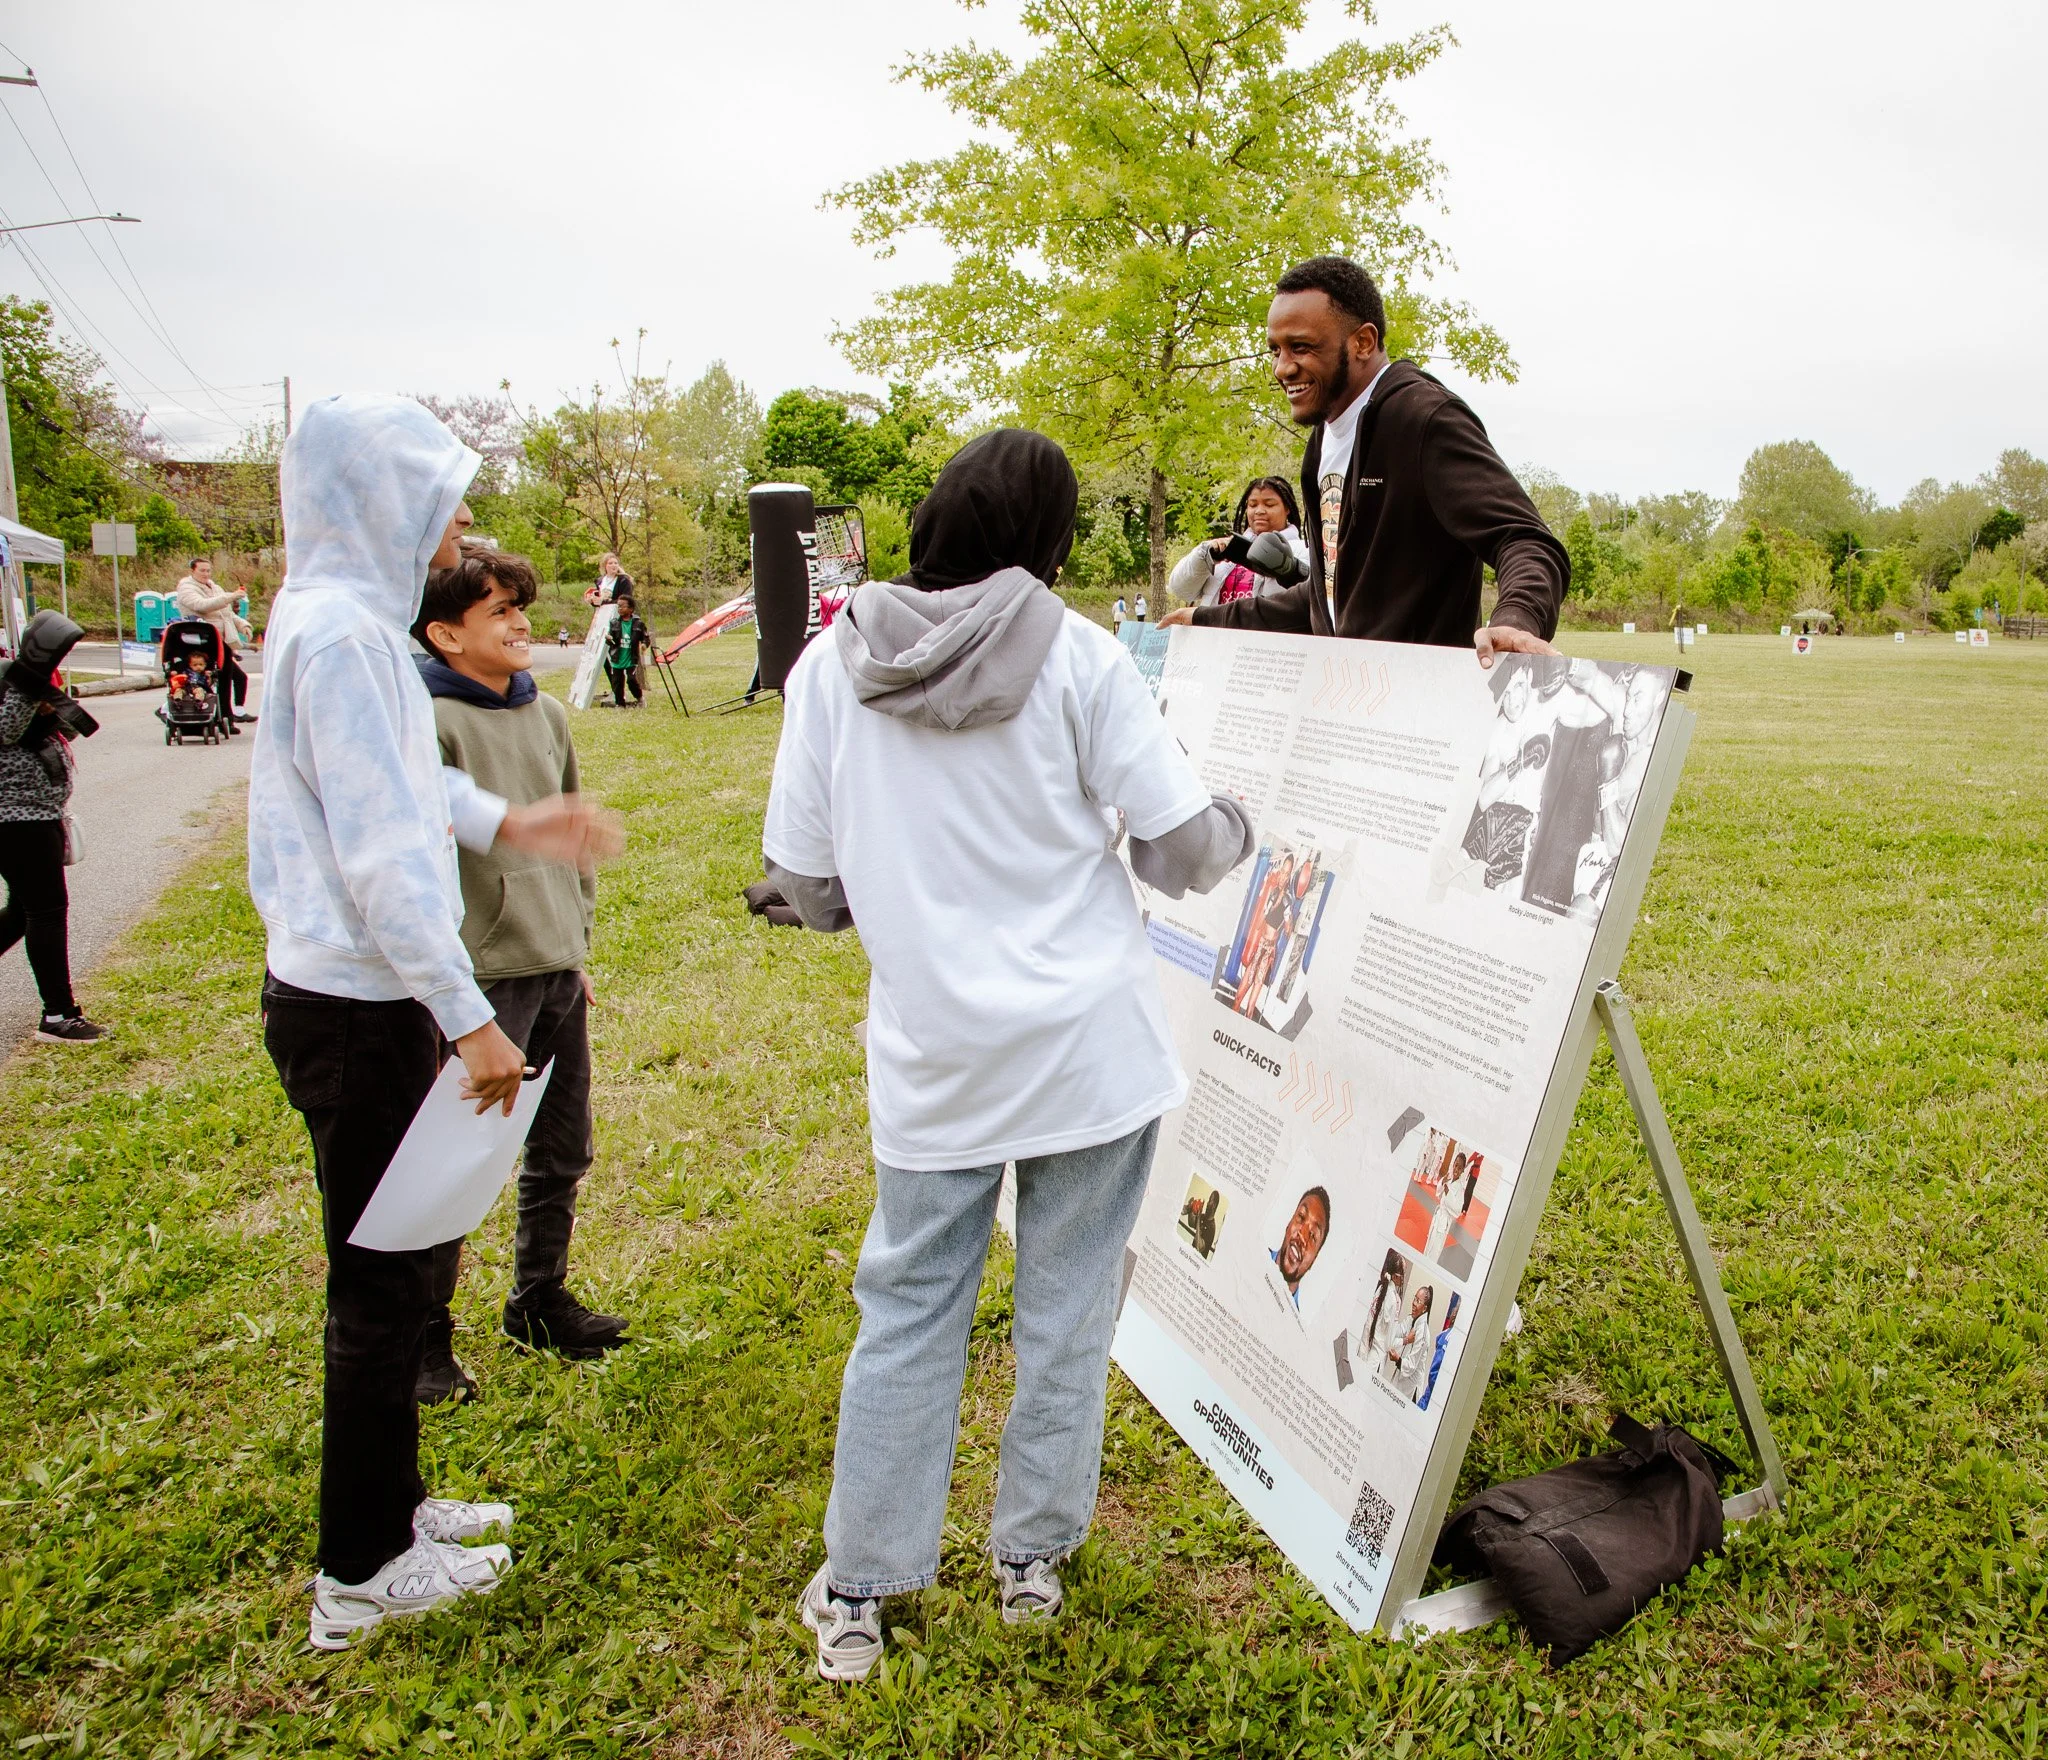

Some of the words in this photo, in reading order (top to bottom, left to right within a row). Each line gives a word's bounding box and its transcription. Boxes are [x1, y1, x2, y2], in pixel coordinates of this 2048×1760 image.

[1423, 800, 1448, 812] Frederick
[1508, 905, 1523, 917] Rocky
[1523, 909, 1539, 921] Jones
[1538, 914, 1554, 925] (right)
[1479, 965, 1496, 977] Gibbs
[1495, 973, 1507, 982] was
[1506, 975, 1518, 986] not
[1516, 979, 1530, 992] just
[1482, 953, 1505, 968] Chester
[1509, 963, 1522, 974] and
[1521, 967, 1532, 978] her
[1530, 971, 1547, 985] story
[1467, 988, 1479, 997] won
[1479, 991, 1489, 1001] her
[1488, 994, 1501, 1006] first
[1500, 999, 1516, 1013] eight
[1471, 1001, 1491, 1015] Valerie
[1482, 979, 1501, 994] player
[1507, 989, 1531, 1004] Chester
[1446, 1003, 1487, 1028] Championship,
[1485, 1020, 1515, 1041] becoming
[1514, 1032, 1526, 1043] the
[1453, 1019, 1471, 1035] (Black
[1469, 1026, 1484, 1040] Belt,
[1482, 1032, 1501, 1048] 2023).
[1213, 1029, 1246, 1057] QUICK
[1246, 1048, 1281, 1077] FACTS
[1445, 1042, 1460, 1055] WKA
[1458, 1048, 1470, 1060] and
[1469, 1053, 1483, 1066] WKF
[1502, 1068, 1514, 1080] Her
[1443, 1056, 1454, 1066] one
[1453, 1059, 1469, 1075] sport
[1472, 1070, 1484, 1082] you
[1483, 1075, 1495, 1085] can
[1494, 1078, 1511, 1093] excel
[1295, 1373, 1306, 1388] then
[1304, 1382, 1327, 1409] competed
[1325, 1401, 1356, 1436] professionally
[1356, 1429, 1364, 1442] for
[1371, 1375, 1381, 1387] YDU
[1380, 1383, 1406, 1409] Participants
[1212, 1403, 1261, 1458] CURRENT
[1290, 1396, 1304, 1414] Today
[1303, 1408, 1311, 1419] he
[1310, 1414, 1324, 1432] offers
[1323, 1426, 1334, 1441] free
[1332, 1436, 1351, 1459] training
[1350, 1452, 1358, 1464] to
[1294, 1386, 1311, 1408] retiring,
[1311, 1401, 1318, 1413] he
[1317, 1407, 1328, 1422] took
[1327, 1418, 1338, 1432] over
[1338, 1426, 1347, 1440] the
[1345, 1434, 1361, 1455] youth
[1193, 1399, 1274, 1490] OPPORTUNITIES
[1287, 1419, 1303, 1440] people
[1302, 1434, 1328, 1463] somewhere
[1326, 1457, 1334, 1469] to
[1333, 1466, 1340, 1478] go
[1340, 1471, 1351, 1486] and
[1294, 1412, 1301, 1423] As
[1299, 1418, 1318, 1442] Pernsley
[1318, 1435, 1333, 1454] knows
[1331, 1448, 1354, 1476] firsthand,
[400, 1575, 432, 1597] N
[1335, 1551, 1350, 1570] Share
[1349, 1565, 1373, 1594] Feedback
[1347, 1581, 1352, 1589] &
[1332, 1582, 1347, 1600] Learn
[1346, 1596, 1360, 1614] More
